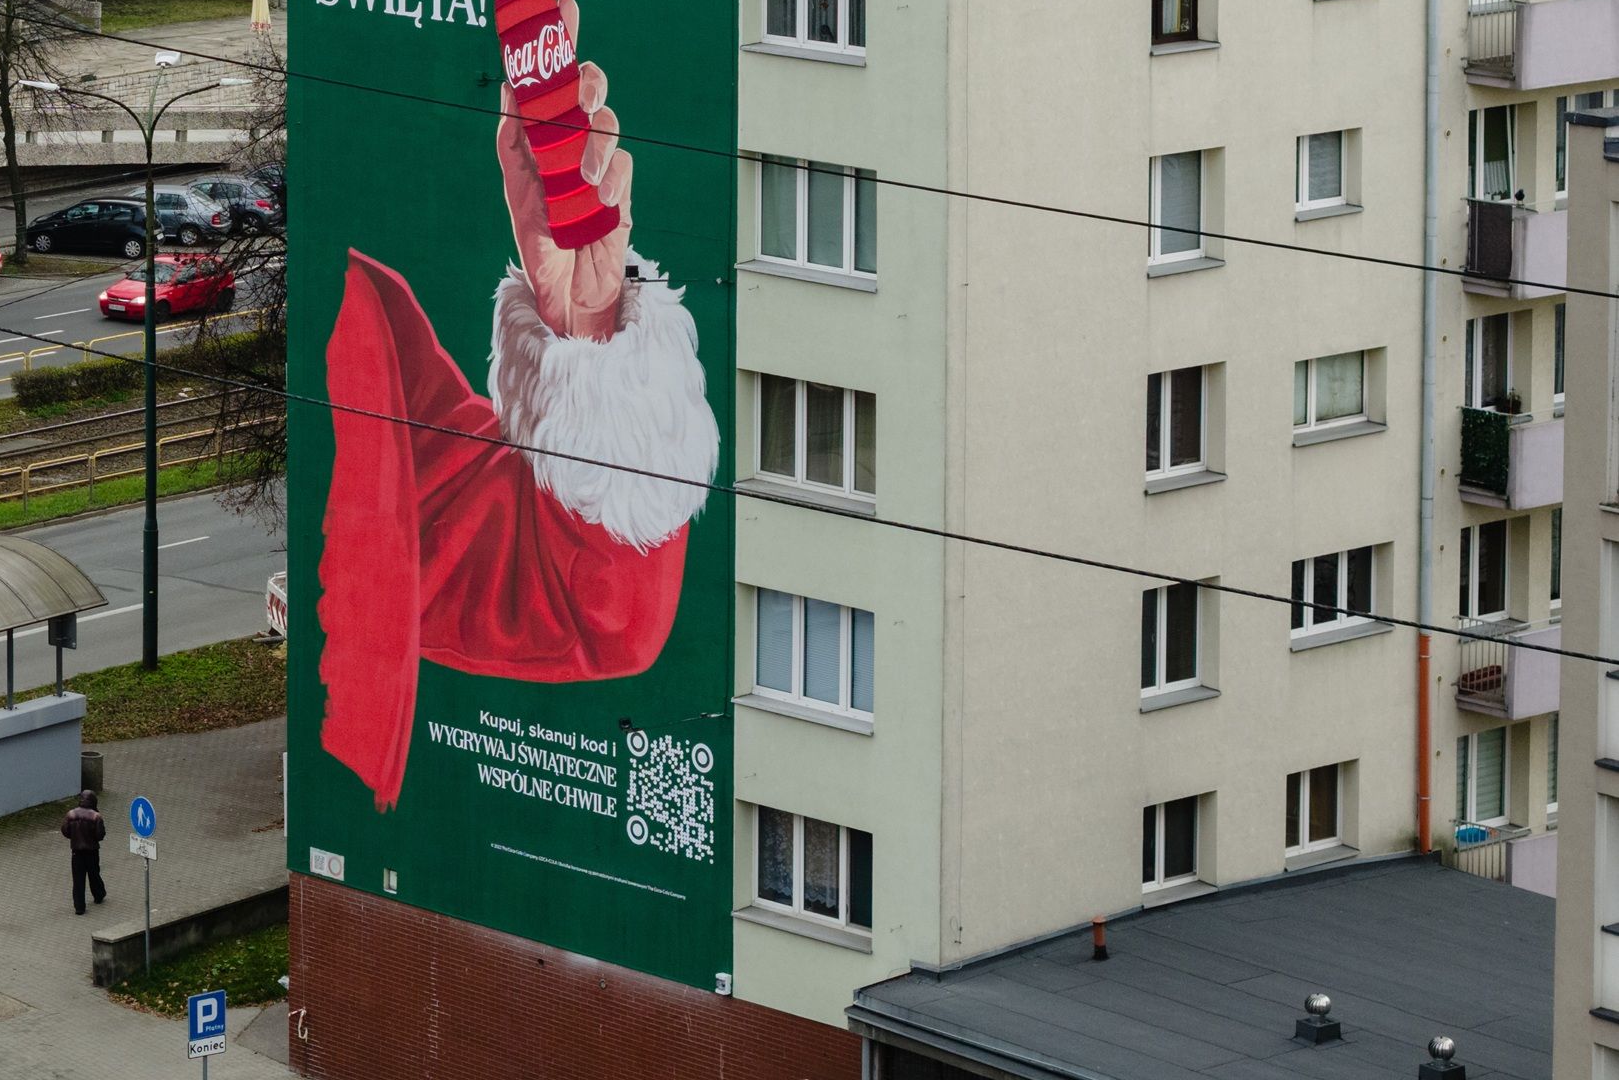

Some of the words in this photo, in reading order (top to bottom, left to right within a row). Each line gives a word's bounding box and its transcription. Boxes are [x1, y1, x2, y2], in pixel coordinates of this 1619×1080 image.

[504, 20, 575, 88] Coca-Cola
[428, 721, 516, 762] WYGRYWAJ
[518, 741, 617, 788] ŚWIĄTECZNE
[480, 710, 525, 737] Kupuj,
[529, 723, 576, 750] skanuj
[580, 734, 608, 755] kod
[612, 742, 617, 757] i
[477, 763, 553, 801] WSPÓLNE
[554, 783, 617, 818] CHWILE
[197, 997, 218, 1034] P
[190, 1041, 224, 1055] Koniec
